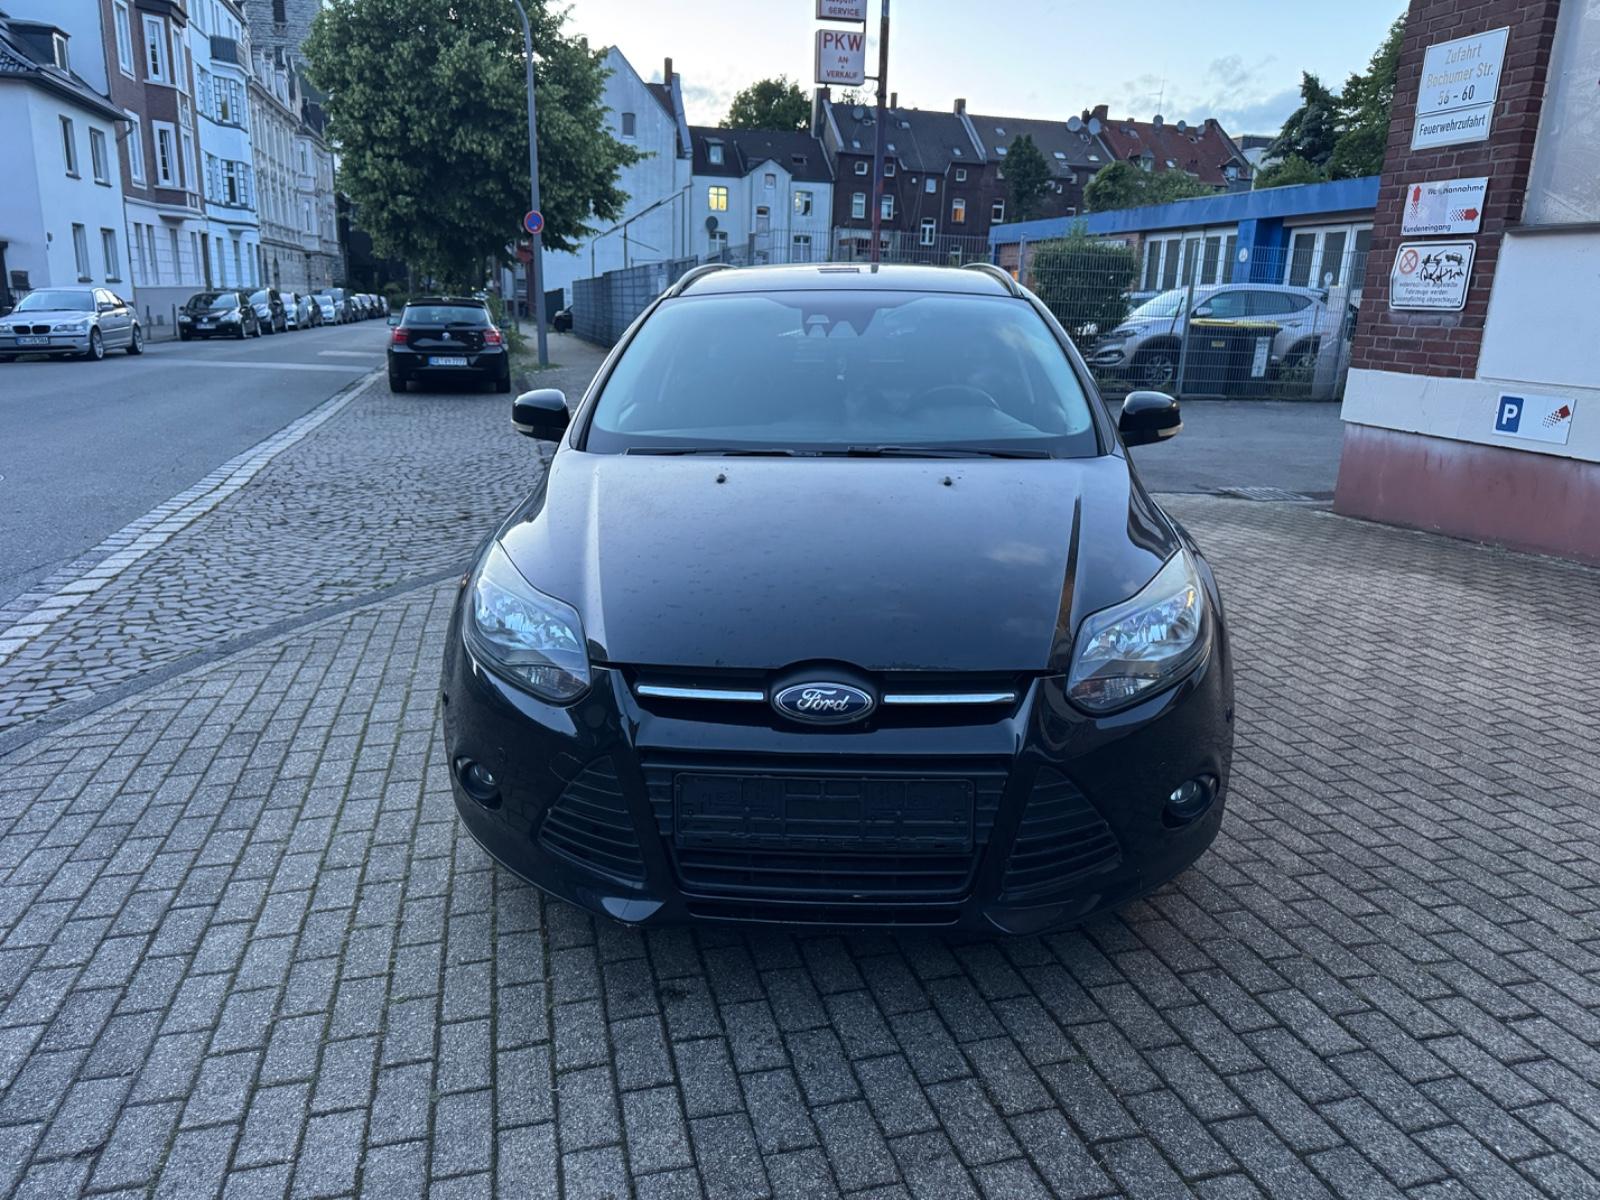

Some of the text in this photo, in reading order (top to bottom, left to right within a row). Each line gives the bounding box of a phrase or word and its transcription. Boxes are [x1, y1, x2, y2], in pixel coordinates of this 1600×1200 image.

[823, 32, 863, 52] PKW
[837, 56, 848, 64] AN
[1445, 43, 1482, 64] Zufahrt
[826, 70, 859, 79] VERKAUF
[1426, 62, 1494, 88] Bochumer Str.
[1437, 89, 1450, 106] 56
[1461, 84, 1476, 101] 60
[1419, 114, 1486, 136] Feuerwehrzufahrt
[1403, 223, 1452, 233] Kundeneingang
[1502, 403, 1518, 425] P
[797, 689, 850, 711] Ford
